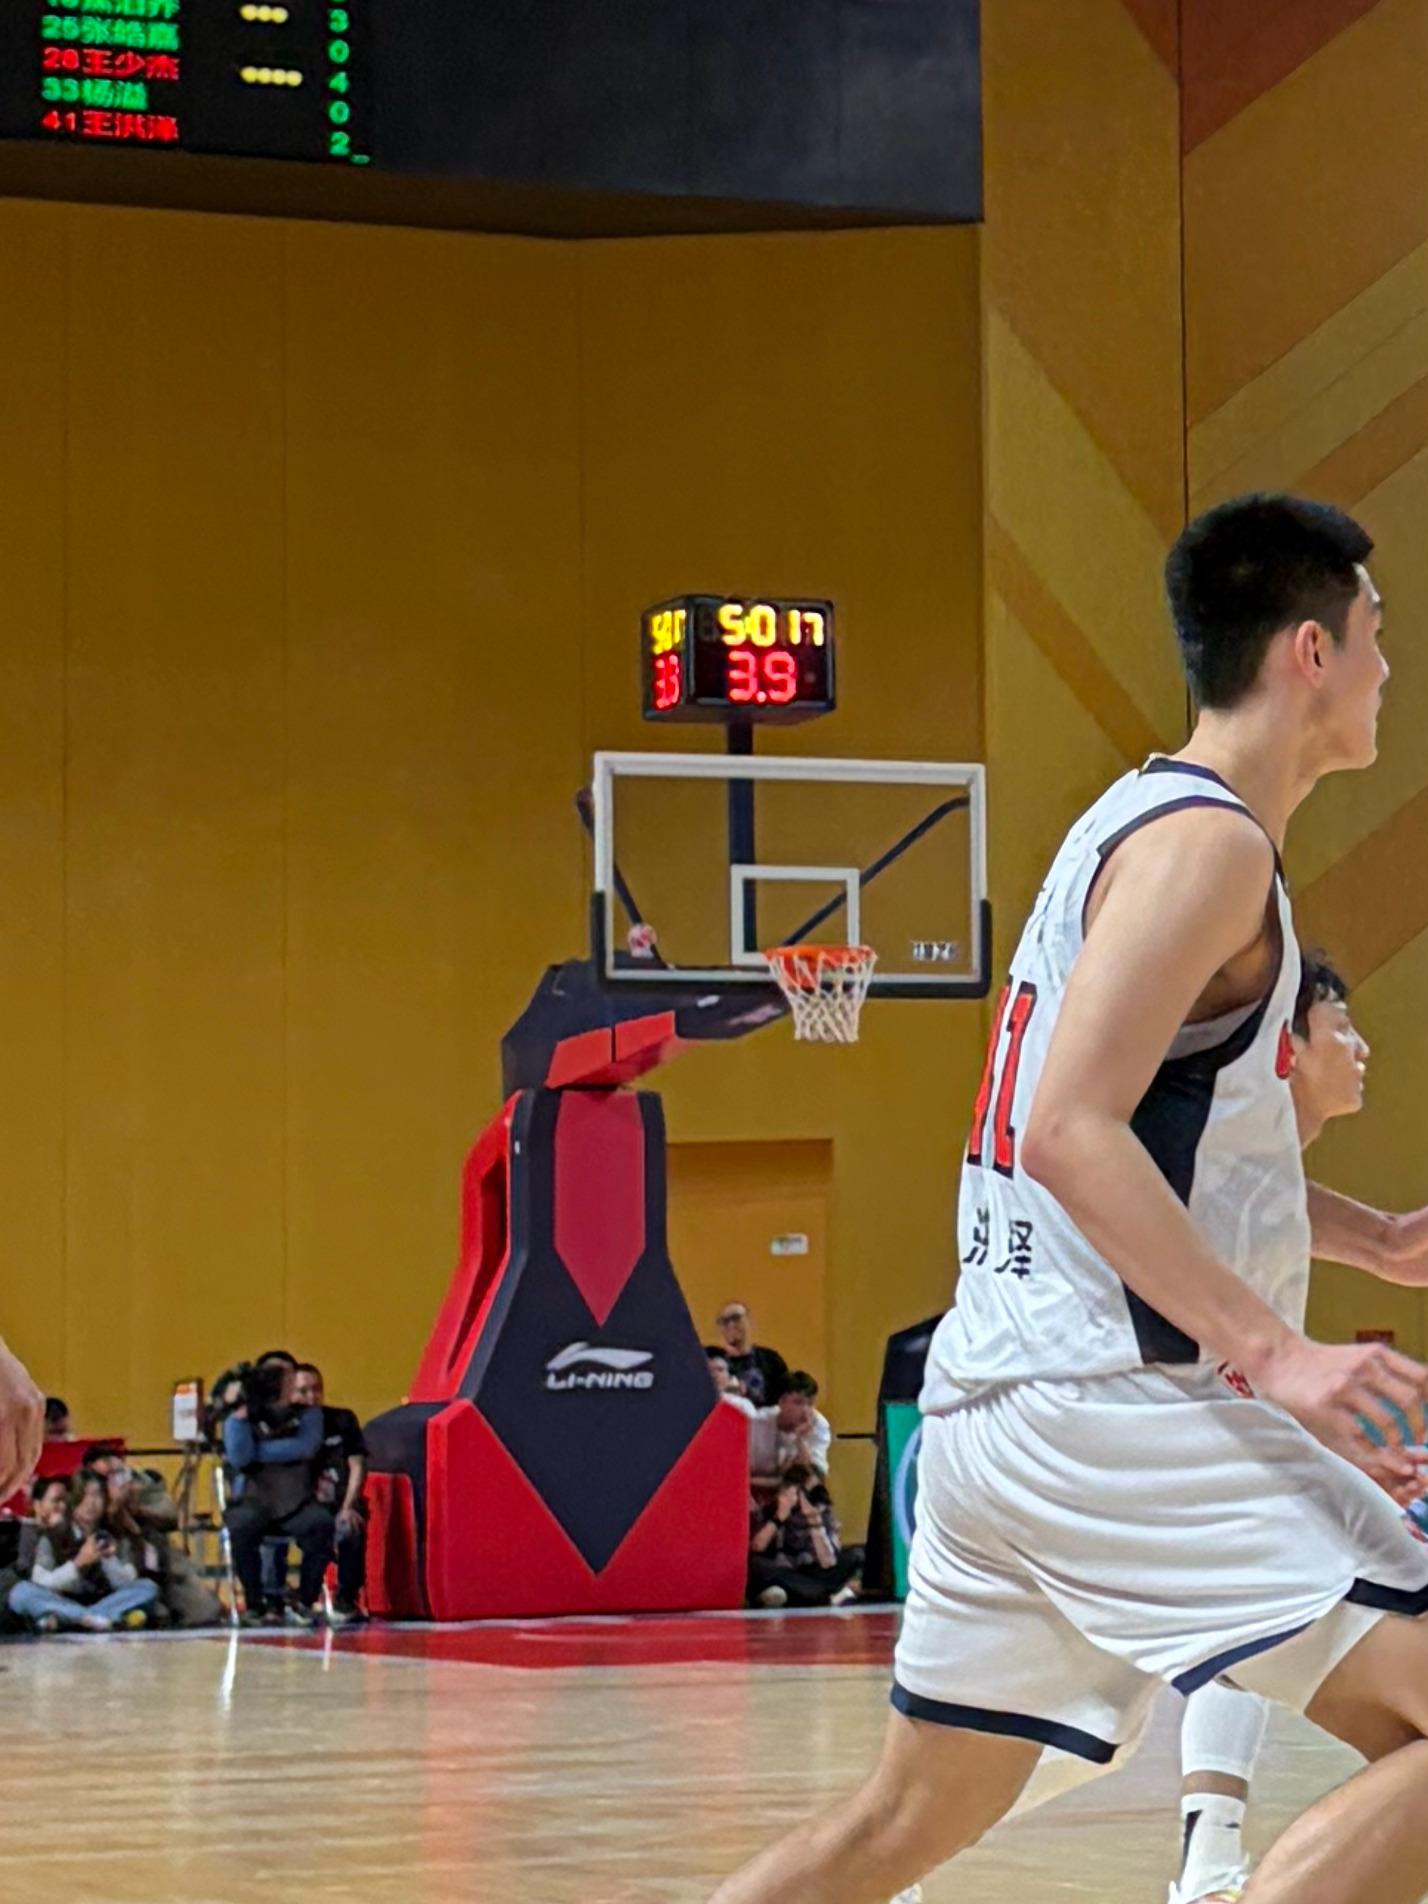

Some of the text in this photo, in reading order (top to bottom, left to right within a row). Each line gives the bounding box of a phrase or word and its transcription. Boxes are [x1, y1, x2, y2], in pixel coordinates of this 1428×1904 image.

[328, 40, 350, 63] 0
[329, 101, 350, 124] 0
[42, 109, 77, 132] 41
[329, 132, 350, 156] 2
[728, 650, 797, 703] 3.9
[546, 1371, 654, 1390] LI-NING
